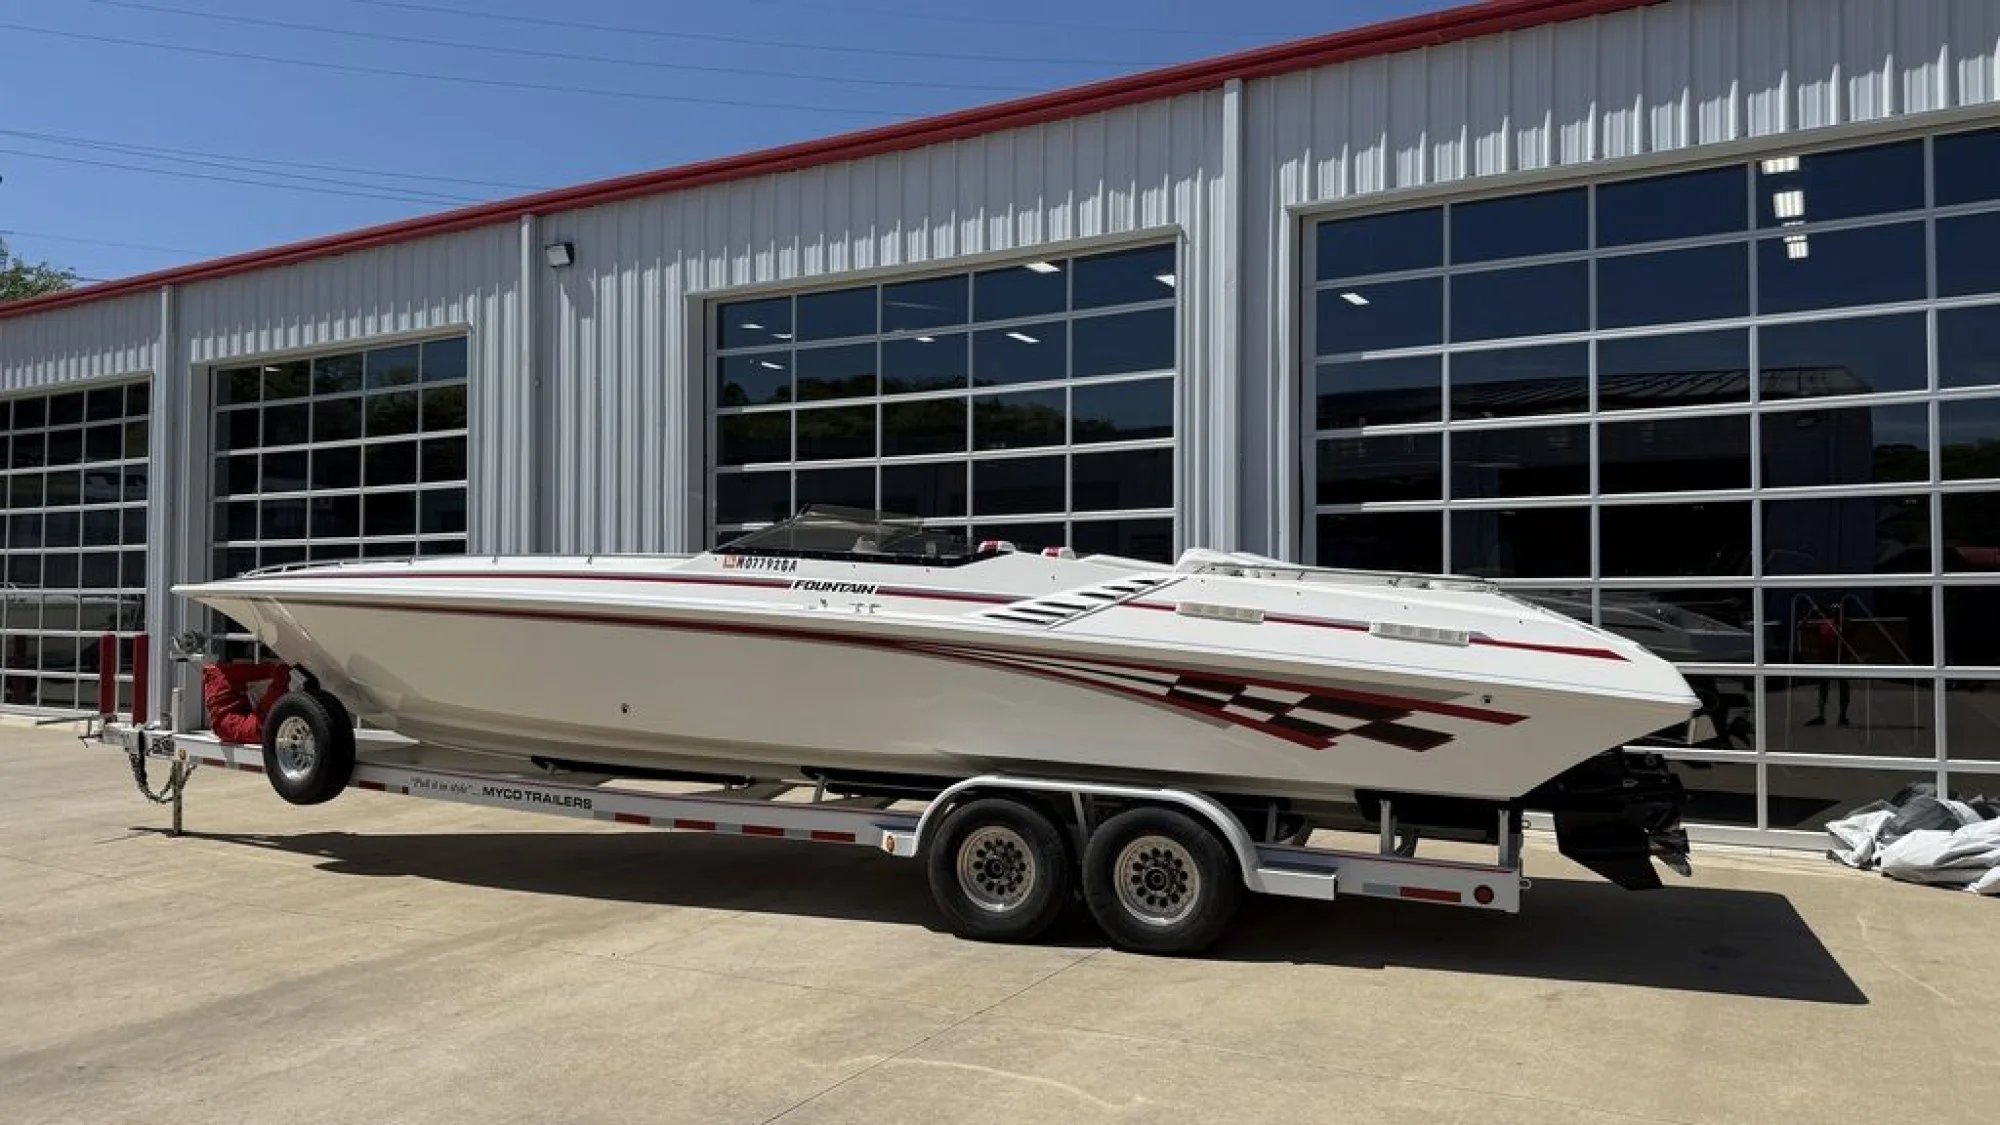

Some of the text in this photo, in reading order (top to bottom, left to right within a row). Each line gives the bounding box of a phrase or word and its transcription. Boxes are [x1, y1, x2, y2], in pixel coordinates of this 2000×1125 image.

[794, 580, 876, 594] FOUNTAIN
[482, 786, 522, 800] MYCO
[524, 790, 593, 809] TRAILERS
